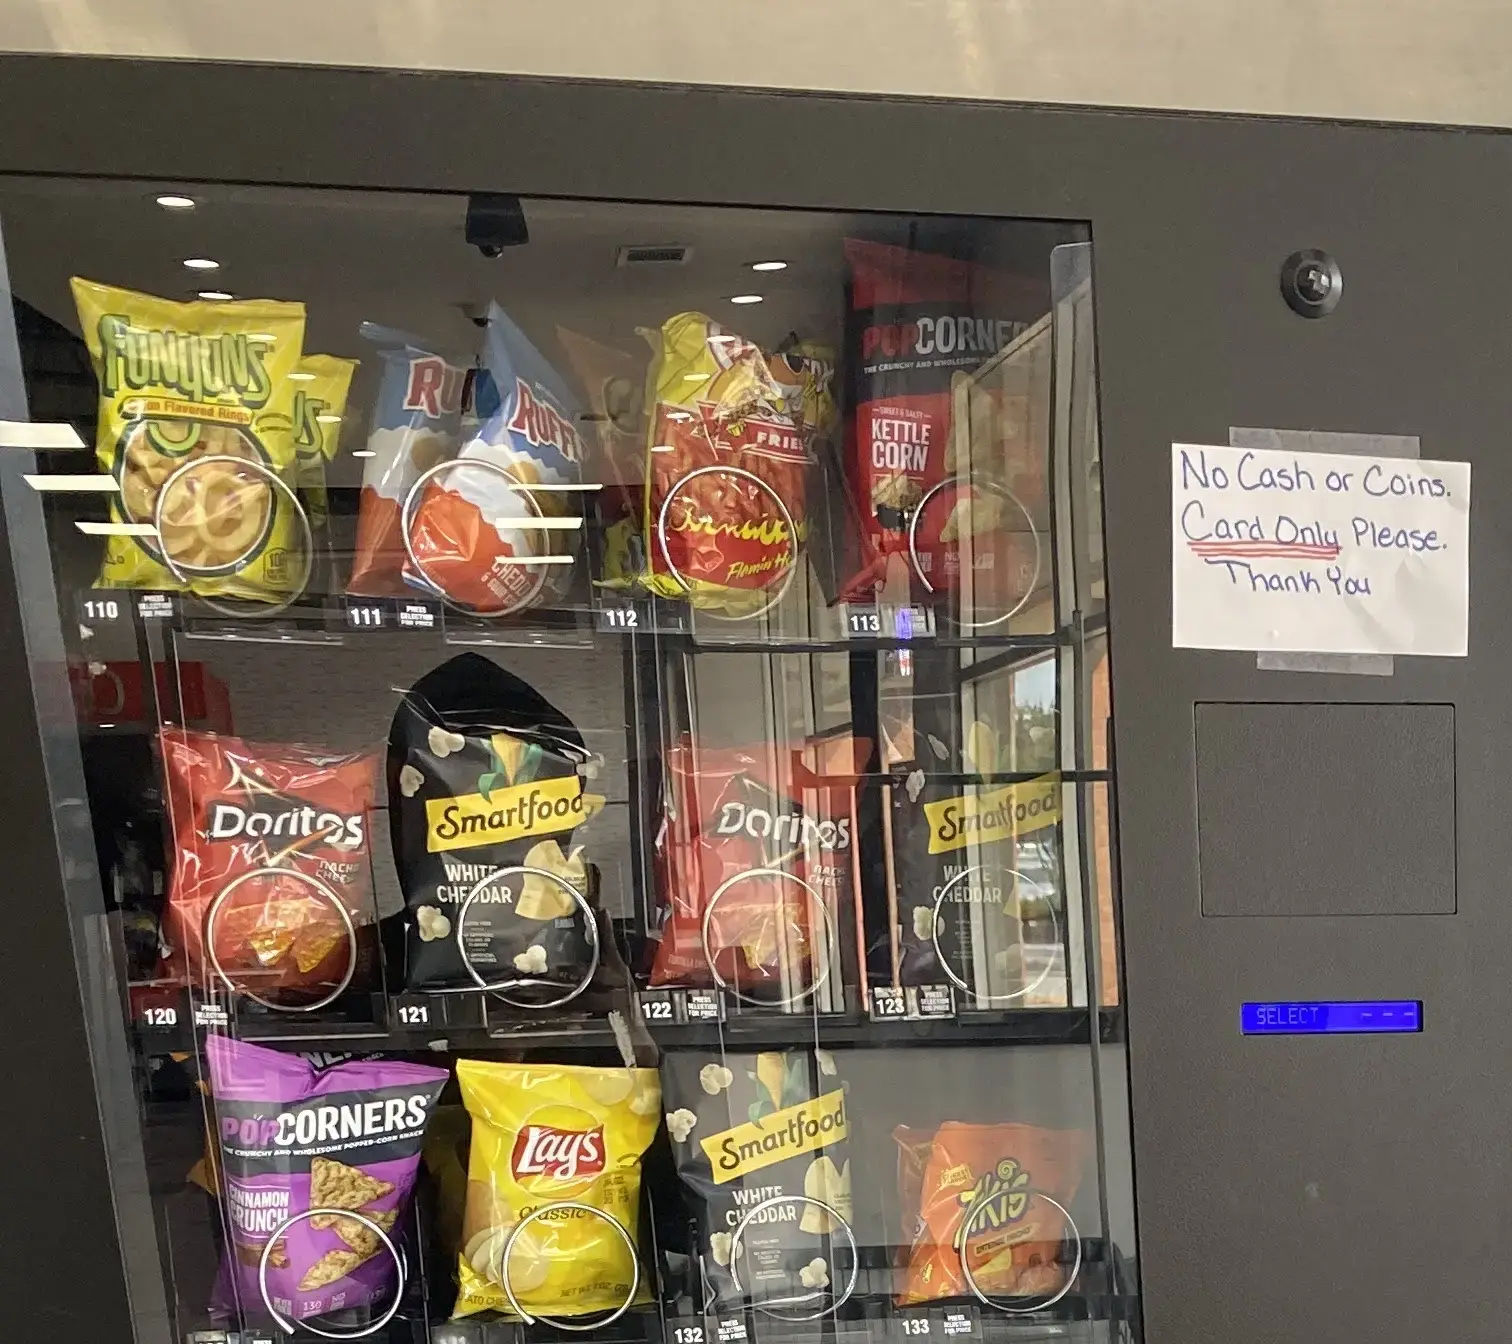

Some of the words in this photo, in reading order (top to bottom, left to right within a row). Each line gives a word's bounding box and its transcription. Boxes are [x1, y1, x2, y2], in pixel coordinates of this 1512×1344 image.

[218, 408, 250, 421] Rings
[871, 418, 931, 445] KETTLE
[871, 441, 930, 472] CORN
[1180, 450, 1229, 489] No
[1238, 451, 1316, 492] Cash
[1325, 470, 1354, 492] or
[1363, 464, 1452, 497] Coins.
[1181, 500, 1264, 541] Card
[1275, 515, 1340, 549] Only
[1351, 516, 1448, 551] Please.
[1204, 558, 1322, 594] Thank
[1326, 565, 1371, 595] You
[85, 600, 118, 619] 110
[350, 607, 382, 626] 111
[606, 610, 638, 627] 112
[850, 615, 880, 631] 113
[938, 786, 1058, 842] Smartfood
[212, 804, 364, 845] Doritos
[717, 802, 850, 850] Doritos
[445, 863, 499, 883] WHITE
[436, 885, 513, 904] CHEDDAR
[398, 1006, 429, 1024] 121
[642, 1001, 672, 1019] 122
[876, 998, 905, 1015] 123
[1256, 1006, 1319, 1026] SELECT
[144, 1008, 177, 1026] 120
[222, 1095, 427, 1148] POPCORNERS
[719, 1099, 845, 1170] Smartfood
[516, 1126, 600, 1180] Lay's
[732, 1185, 783, 1206] WHITE
[232, 1204, 289, 1232] CRUNCH
[725, 1204, 798, 1227] CHEDDAR
[674, 1327, 704, 1344] 132
[902, 1318, 930, 1335] 133
